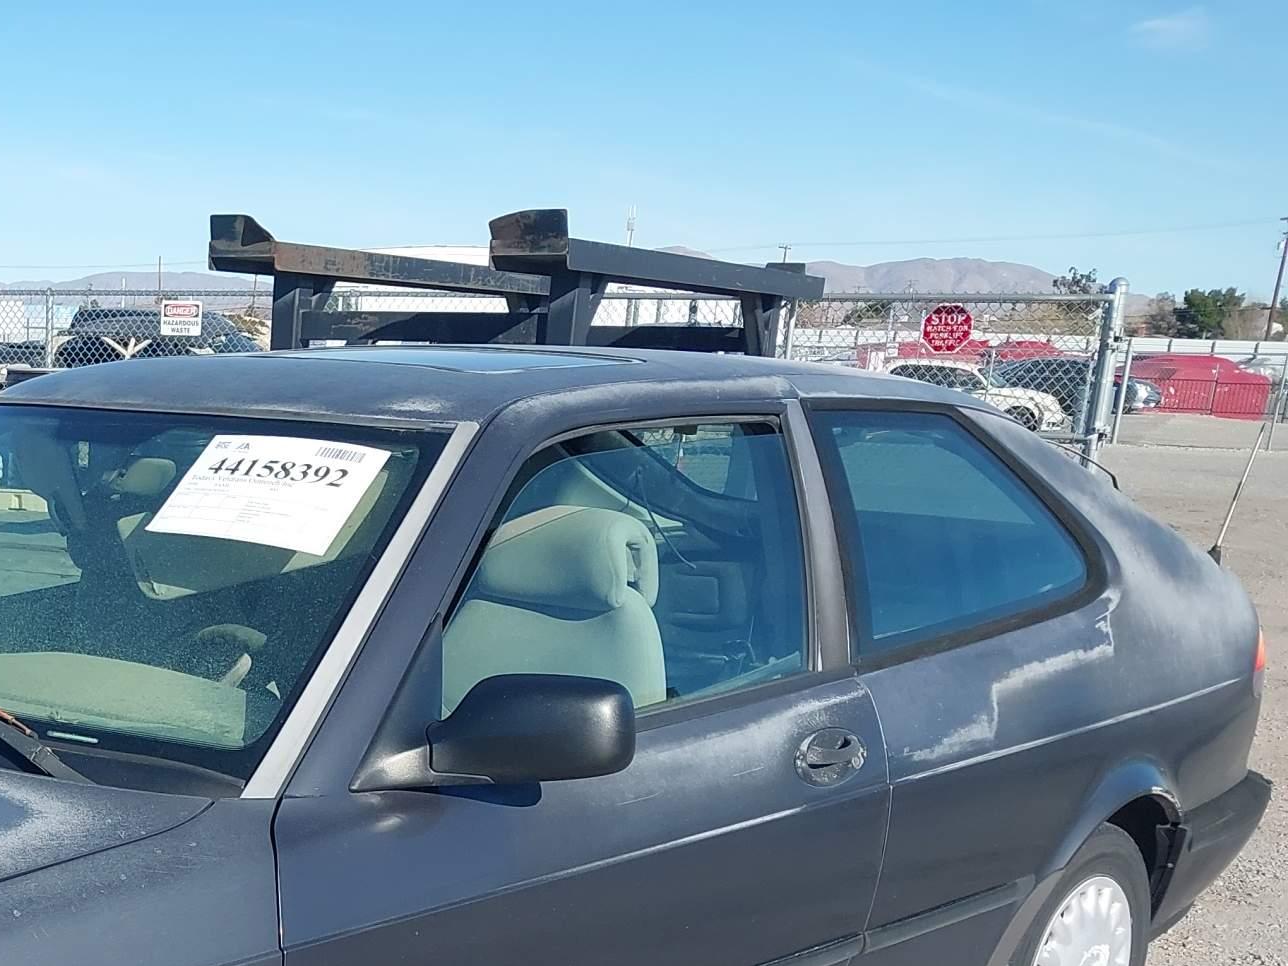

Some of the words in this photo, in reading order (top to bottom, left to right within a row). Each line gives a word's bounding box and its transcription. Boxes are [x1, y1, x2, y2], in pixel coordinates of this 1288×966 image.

[163, 319, 200, 327] HAZARDOUS
[931, 313, 966, 325] STOP
[208, 457, 349, 488] 44158392
